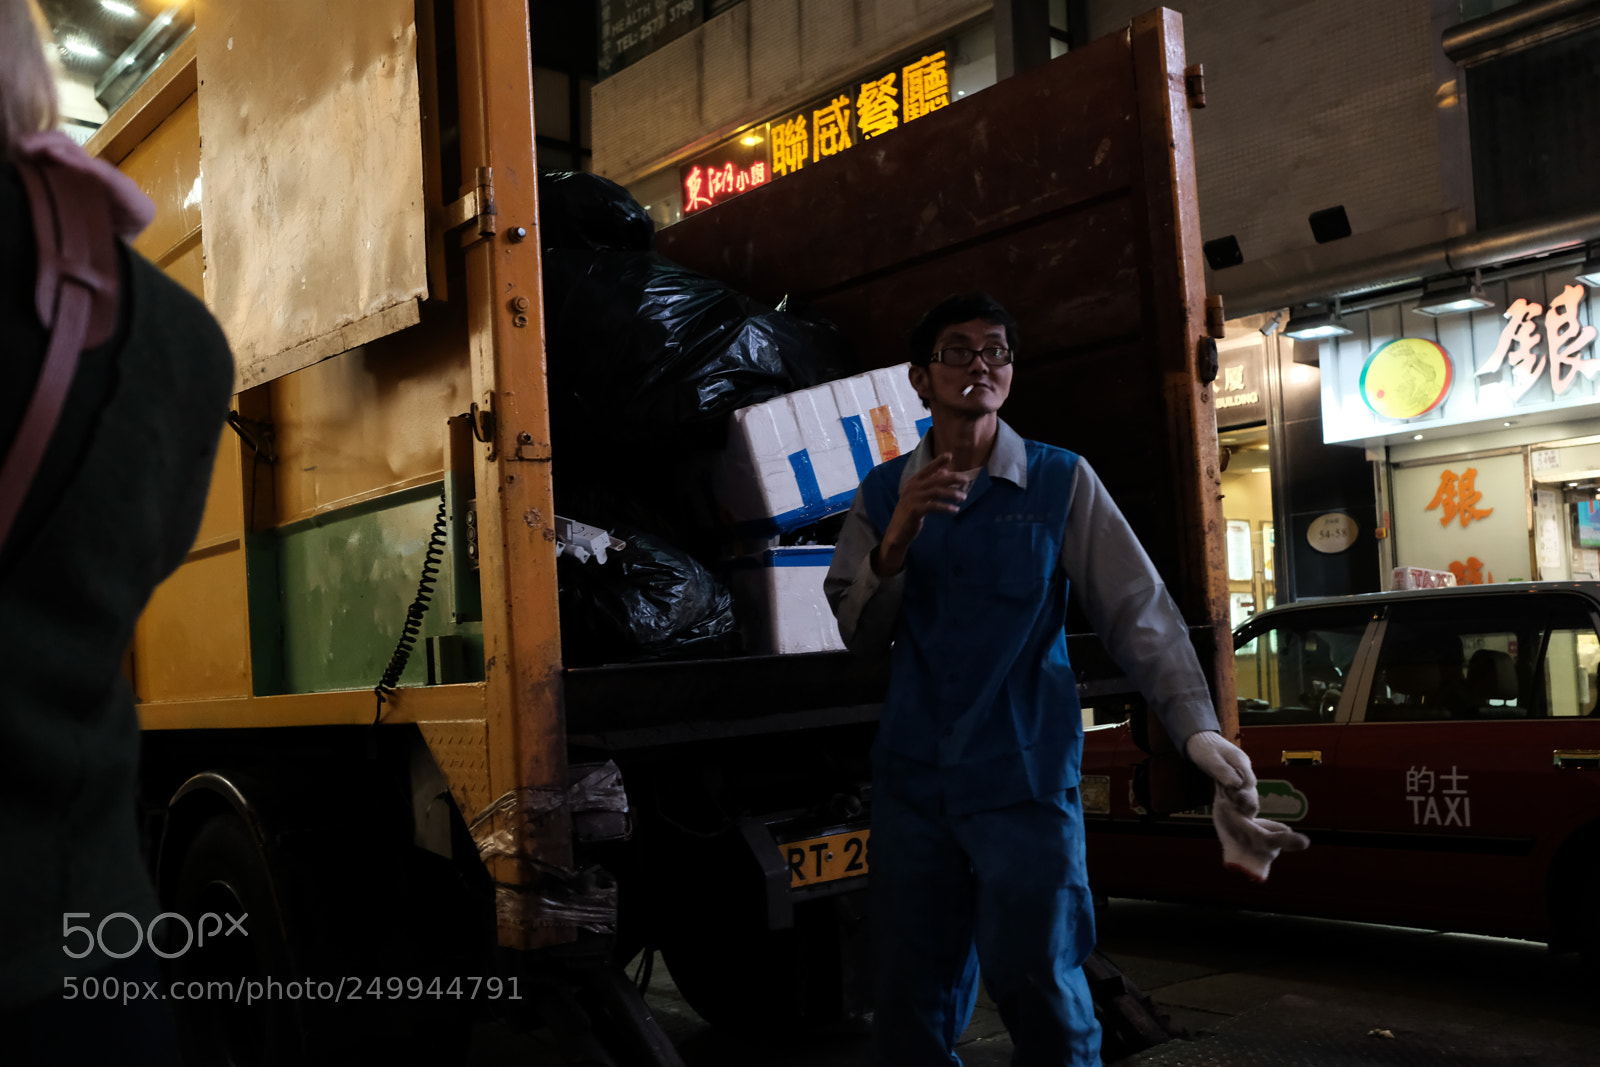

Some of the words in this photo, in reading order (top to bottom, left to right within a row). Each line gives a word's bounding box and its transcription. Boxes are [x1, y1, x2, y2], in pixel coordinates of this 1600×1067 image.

[1474, 284, 1600, 404] 銀
[1406, 765, 1469, 794] 的士
[1405, 795, 1471, 827] TAXI
[788, 843, 828, 880] RT
[844, 838, 870, 872] 2
